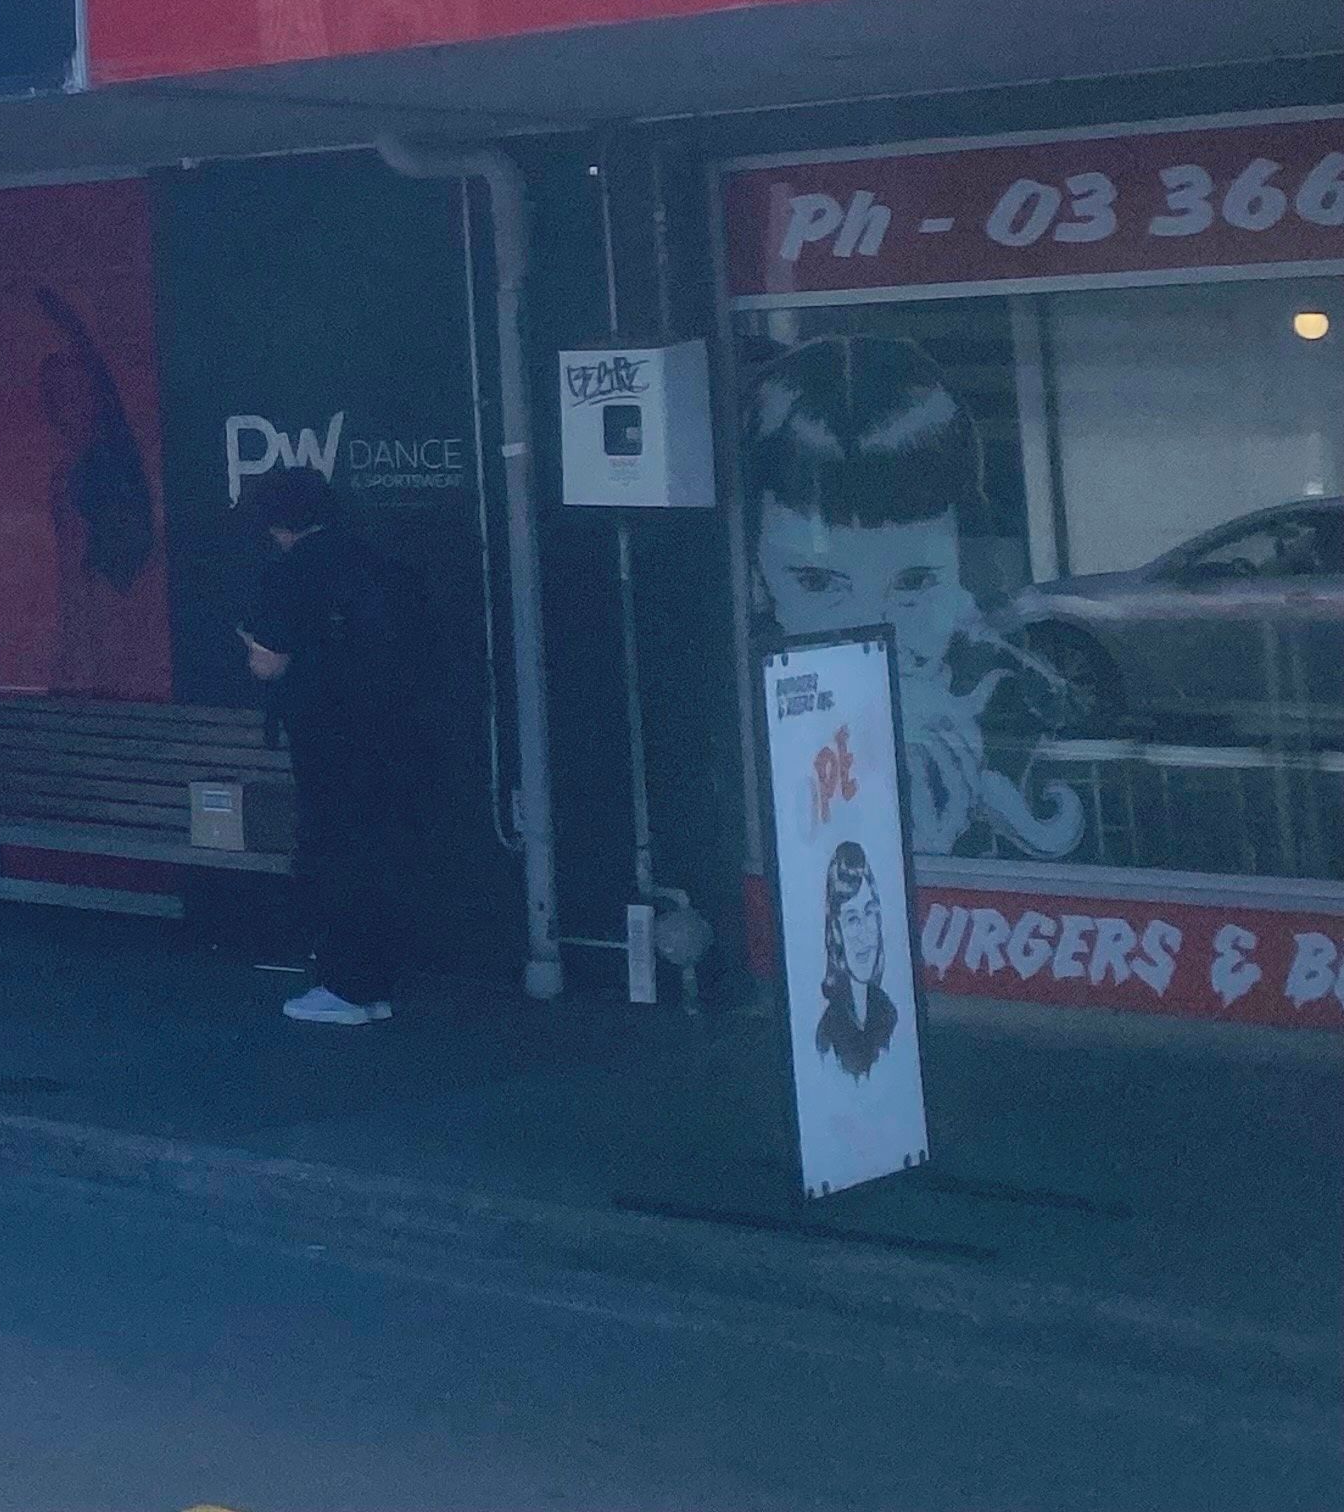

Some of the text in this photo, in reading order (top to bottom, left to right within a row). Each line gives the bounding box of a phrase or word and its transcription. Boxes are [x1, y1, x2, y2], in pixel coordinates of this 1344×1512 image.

[780, 190, 892, 262] Ph
[985, 172, 1118, 248] 03
[1147, 150, 1344, 238] 366
[348, 438, 463, 470] DANCE
[920, 903, 1183, 997] URGERS
[1283, 932, 1344, 1010] B
